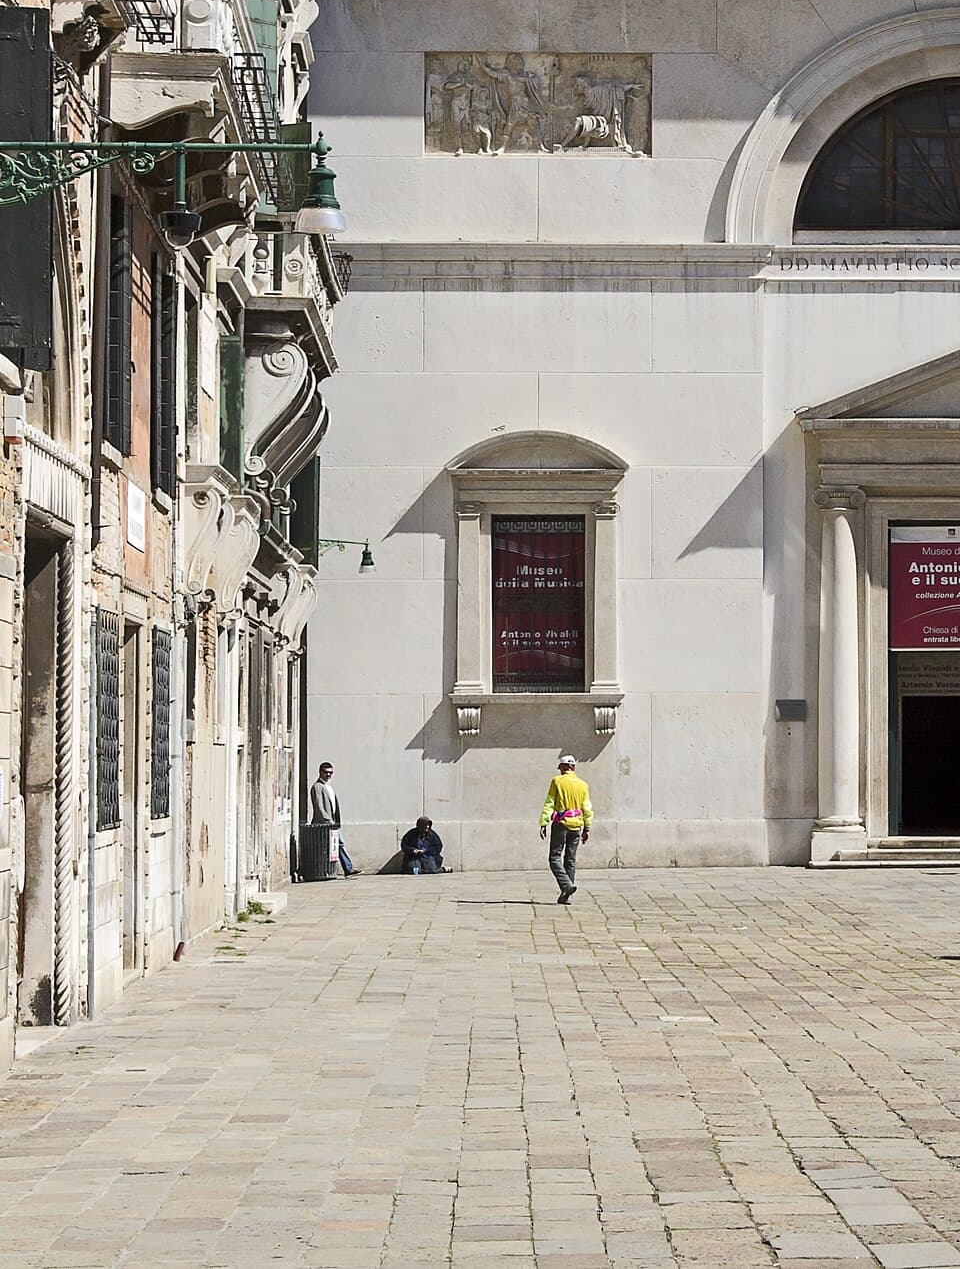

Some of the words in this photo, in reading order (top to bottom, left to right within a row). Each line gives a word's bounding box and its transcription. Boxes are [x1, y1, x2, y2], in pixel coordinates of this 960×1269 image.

[922, 547, 952, 556] Museo
[516, 565, 563, 575] Museo
[912, 576, 920, 585] e
[926, 574, 935, 585] il
[500, 630, 541, 638] Antono
[922, 626, 950, 634] Chiesa
[952, 626, 958, 634] di
